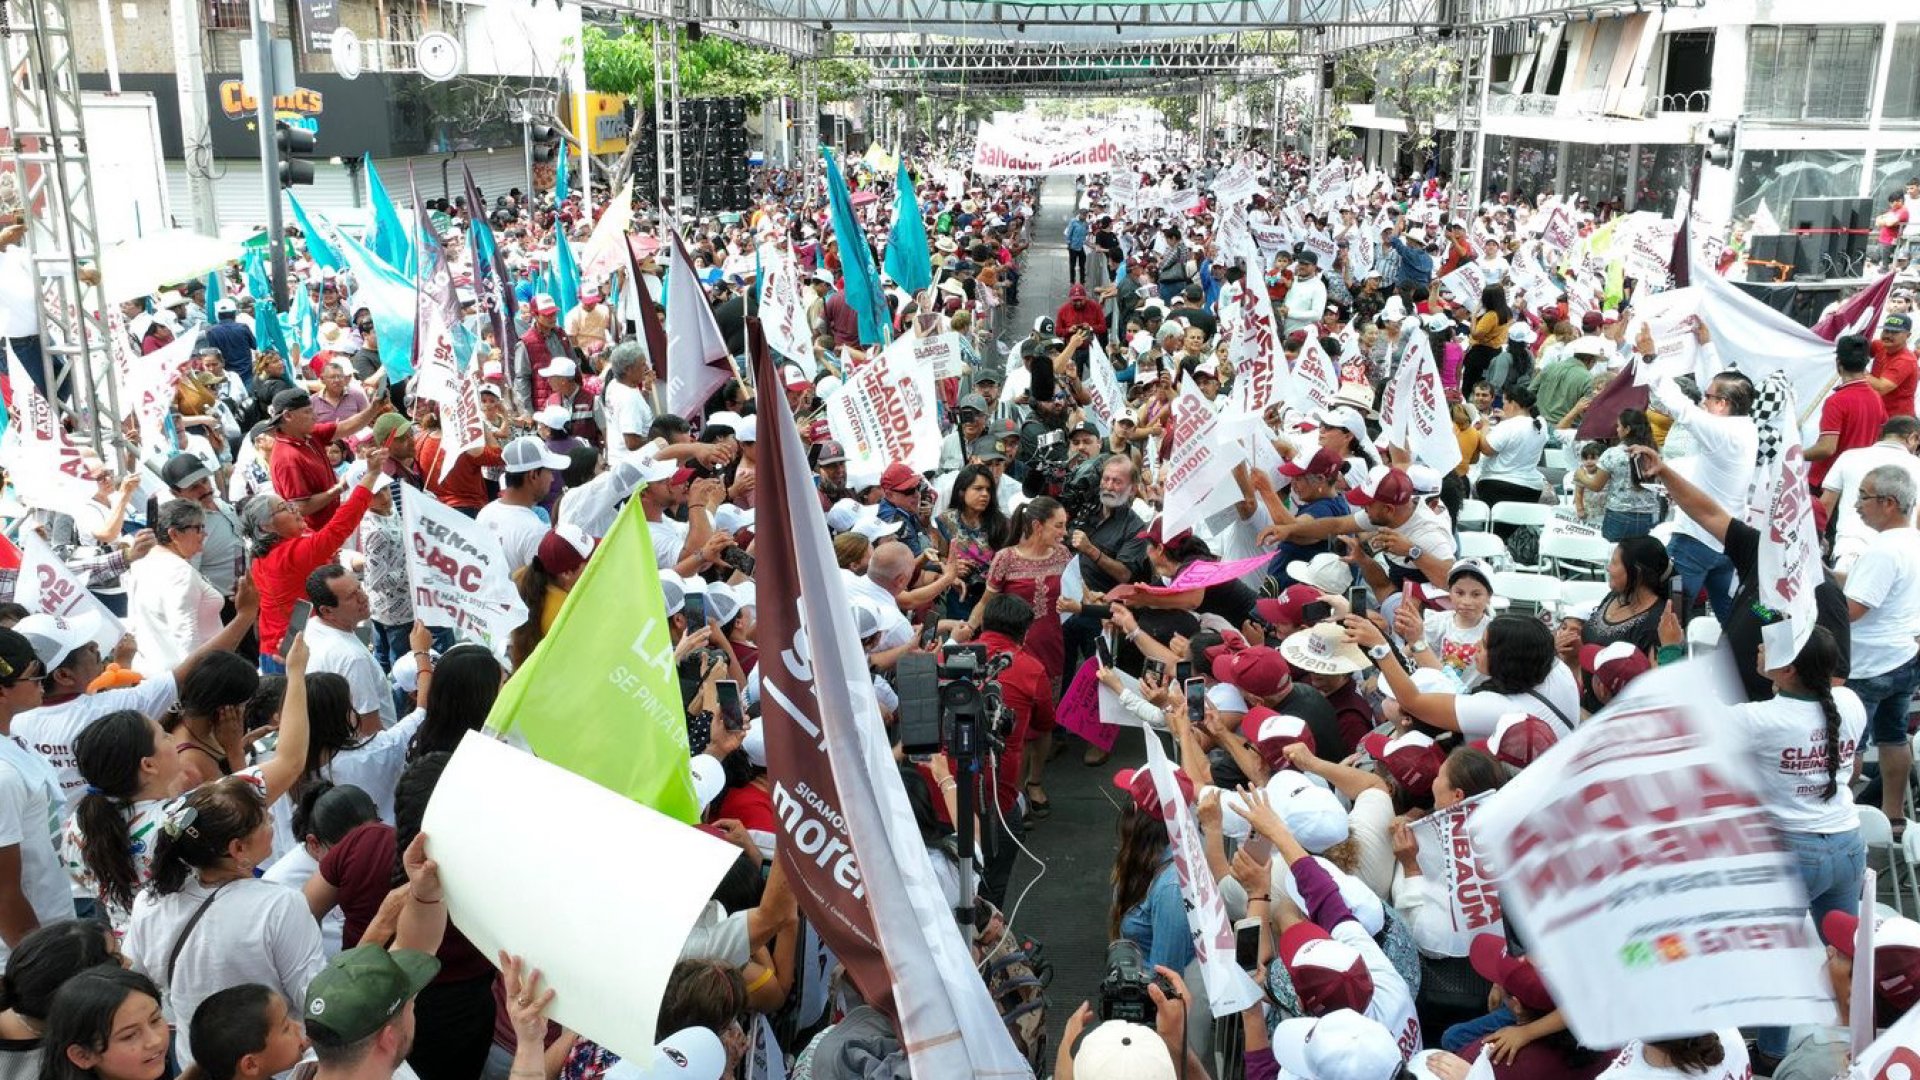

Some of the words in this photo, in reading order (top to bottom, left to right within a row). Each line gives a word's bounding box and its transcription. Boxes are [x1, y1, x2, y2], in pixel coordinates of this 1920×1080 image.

[841, 395, 866, 442] morena
[872, 356, 915, 460] CLAUDIA
[609, 665, 640, 693] SE
[1781, 739, 1855, 761] CLAUIA
[772, 780, 865, 899] more
